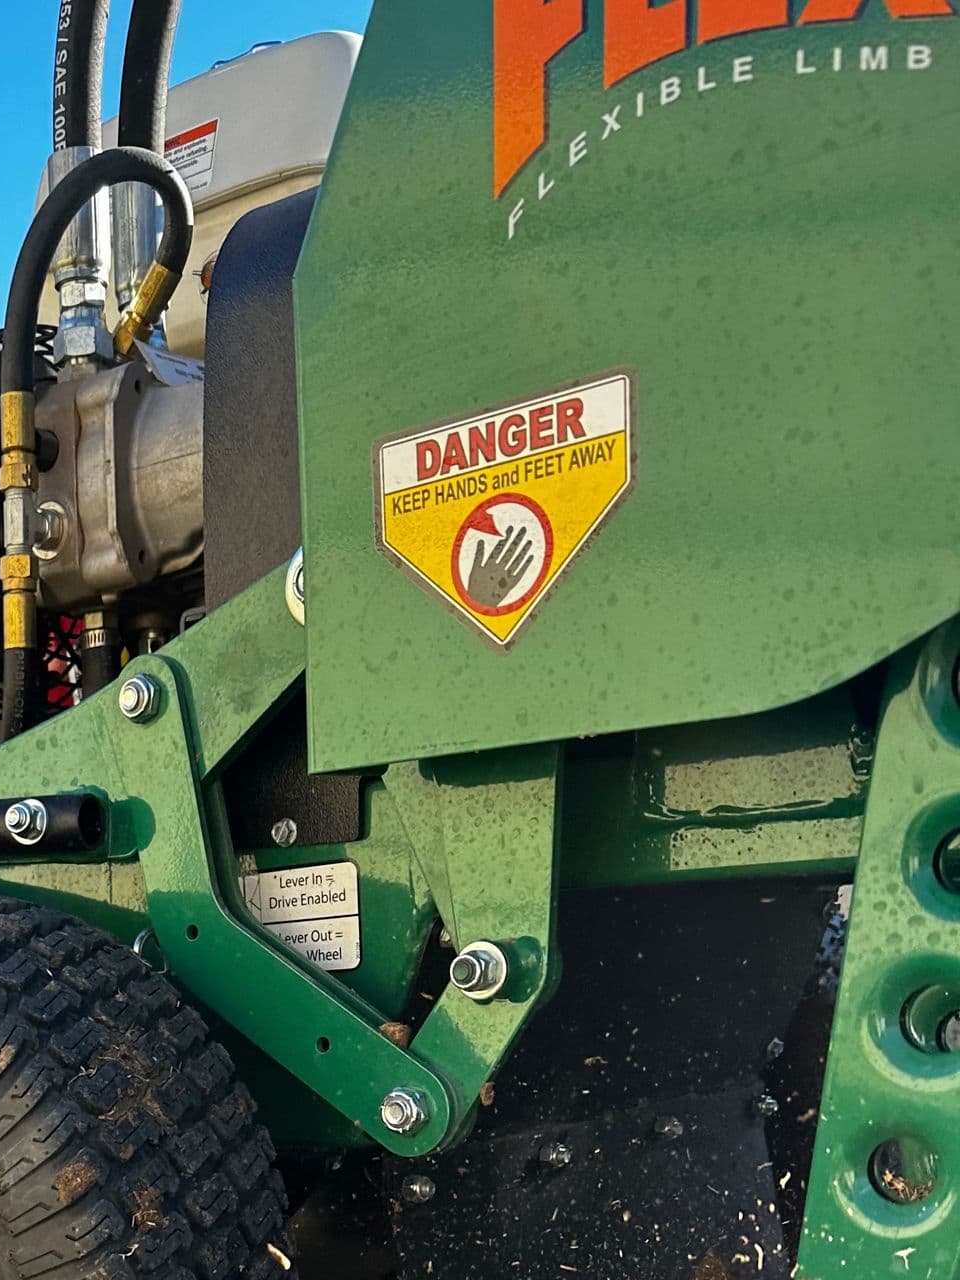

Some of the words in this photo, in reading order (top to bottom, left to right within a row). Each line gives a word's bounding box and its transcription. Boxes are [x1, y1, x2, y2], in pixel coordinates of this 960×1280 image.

[58, 0, 71, 31] 53
[54, 49, 68, 99] SAE
[508, 56, 754, 240] FLEXIBLE
[795, 45, 934, 75] LIMB
[415, 397, 587, 482] DANGER
[392, 489, 431, 516] KEEP
[434, 473, 488, 506] HANDS
[492, 464, 519, 491] and
[524, 452, 565, 483] FEET
[568, 438, 616, 472] AWAY
[279, 875, 310, 889] Lever
[311, 872, 323, 885] In
[269, 895, 299, 910] Drive
[300, 888, 346, 906] Enabled
[310, 929, 333, 942] Out
[306, 947, 342, 961] Wheel
